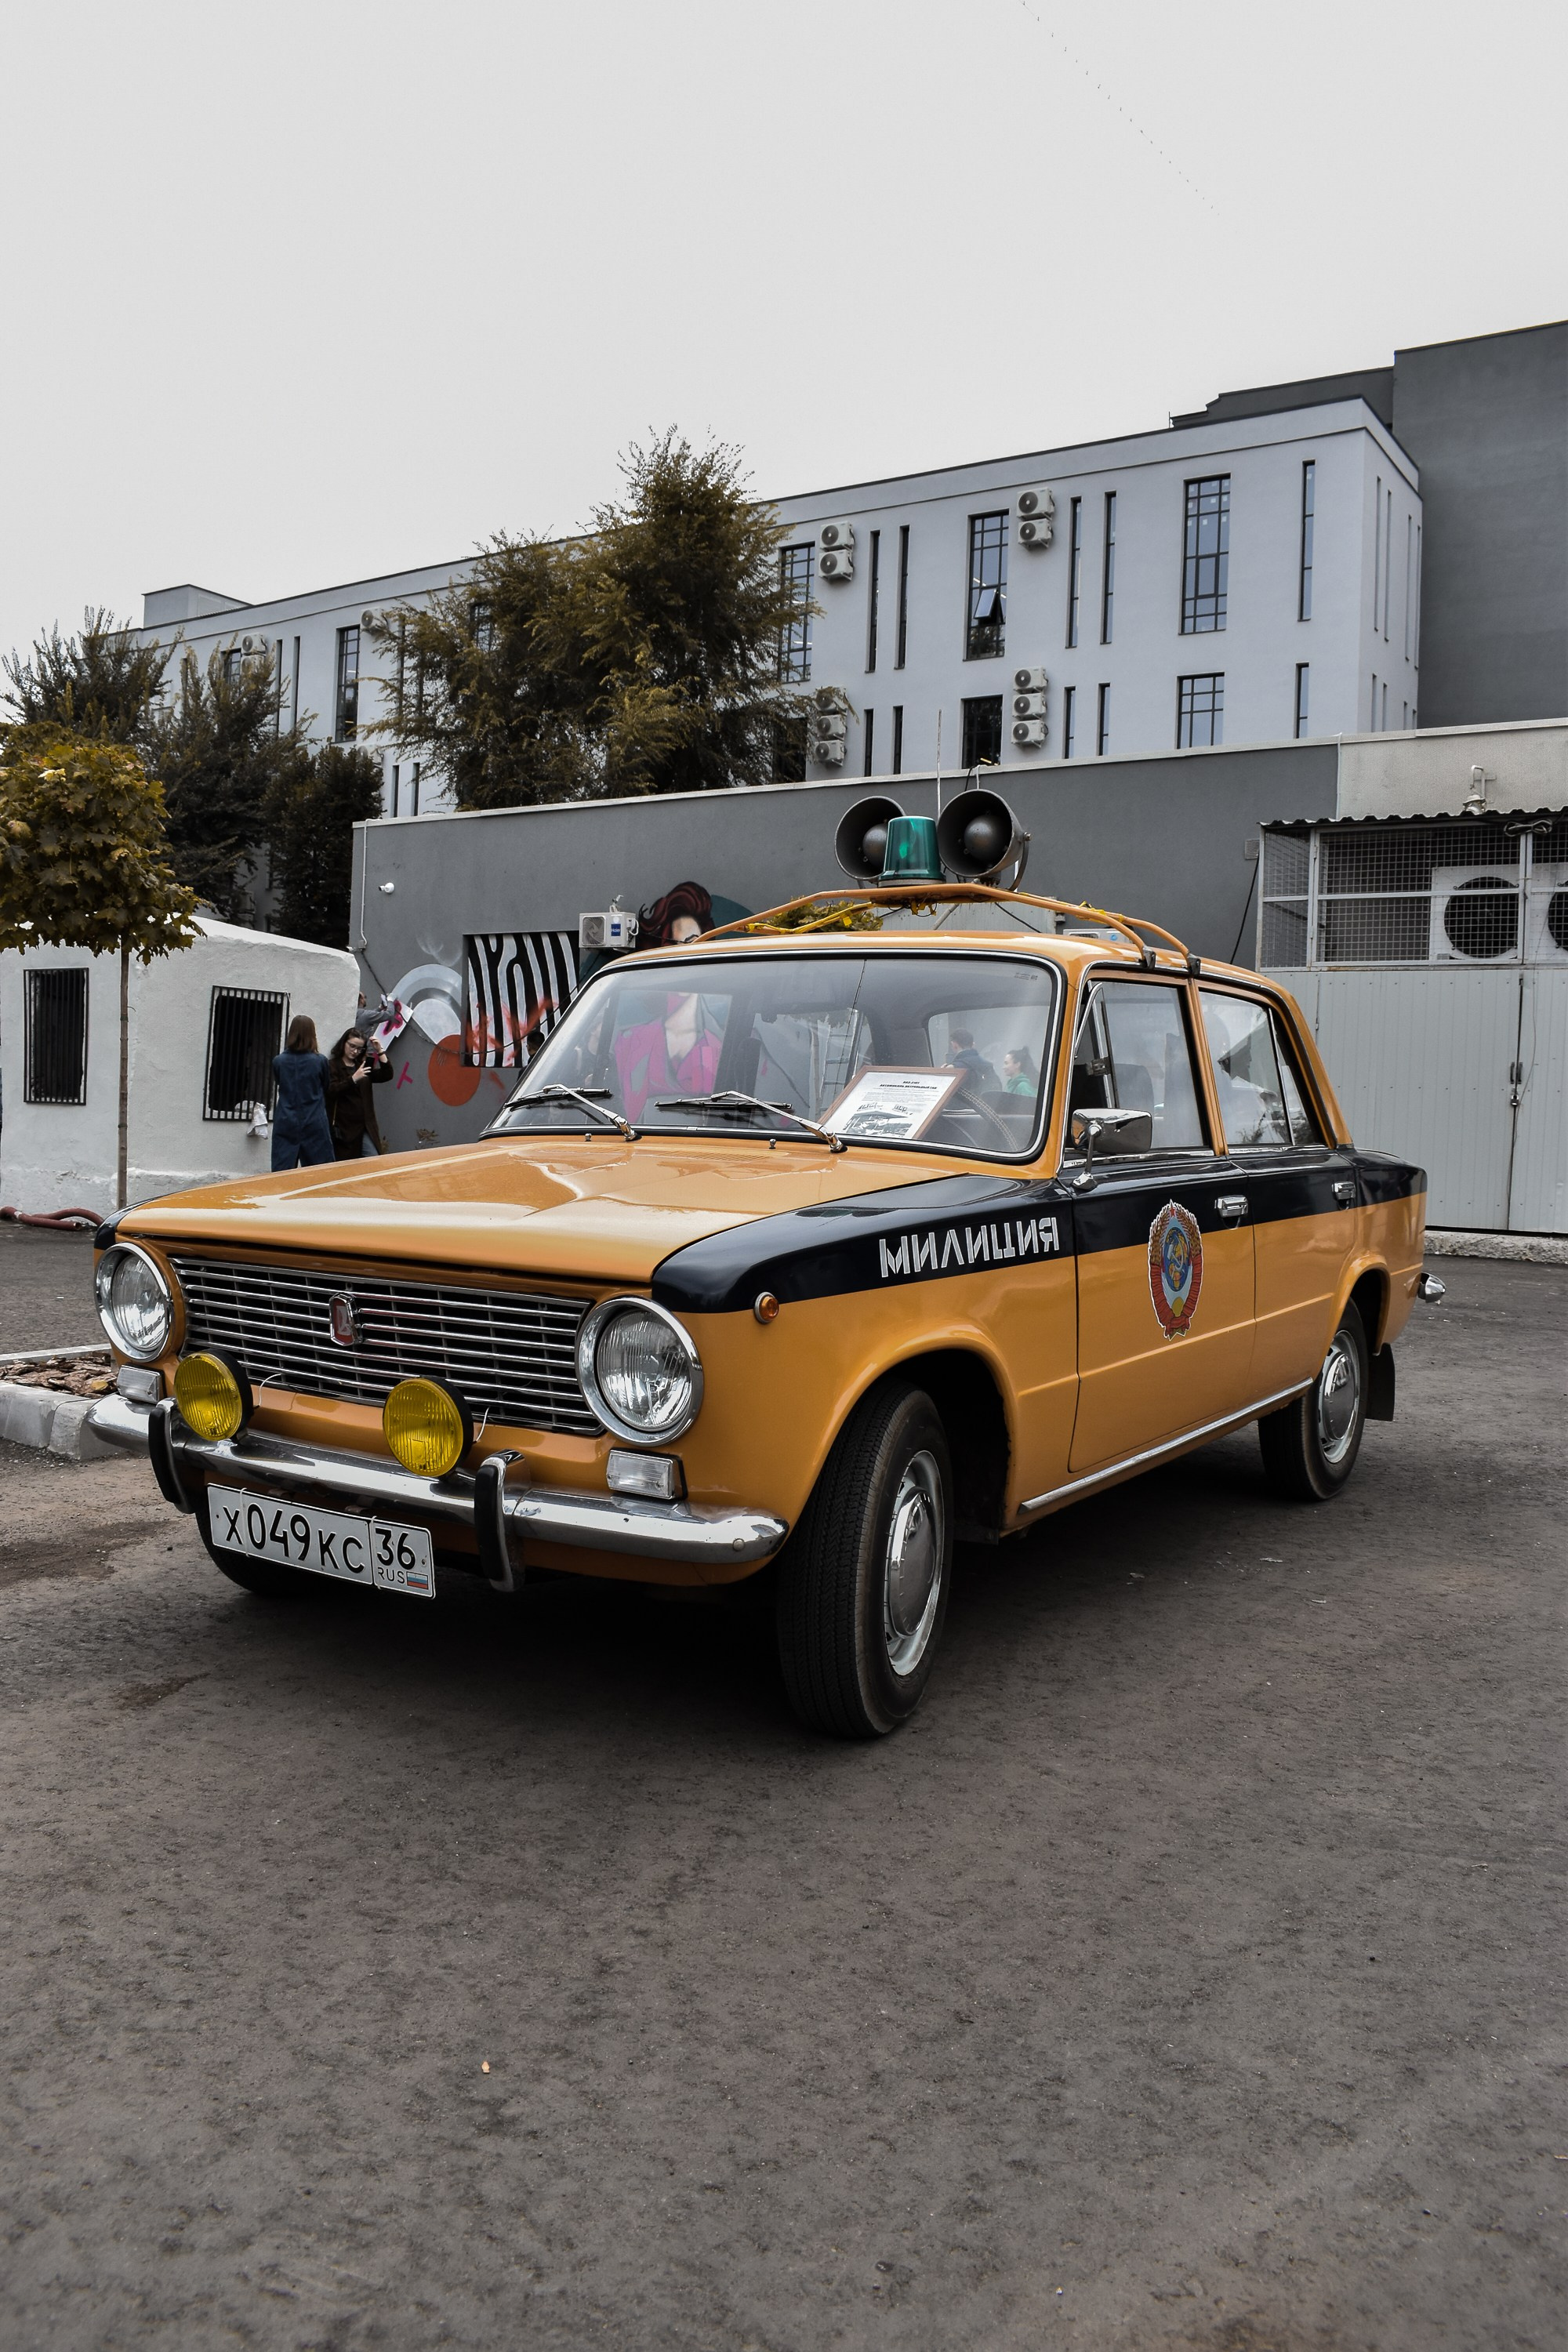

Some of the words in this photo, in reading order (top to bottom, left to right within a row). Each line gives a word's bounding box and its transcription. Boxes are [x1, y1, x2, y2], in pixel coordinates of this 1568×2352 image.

[879, 1217, 1059, 1278] МИЛИЦИЯ
[375, 1527, 416, 1570] 36
[378, 1566, 405, 1584] RUS
